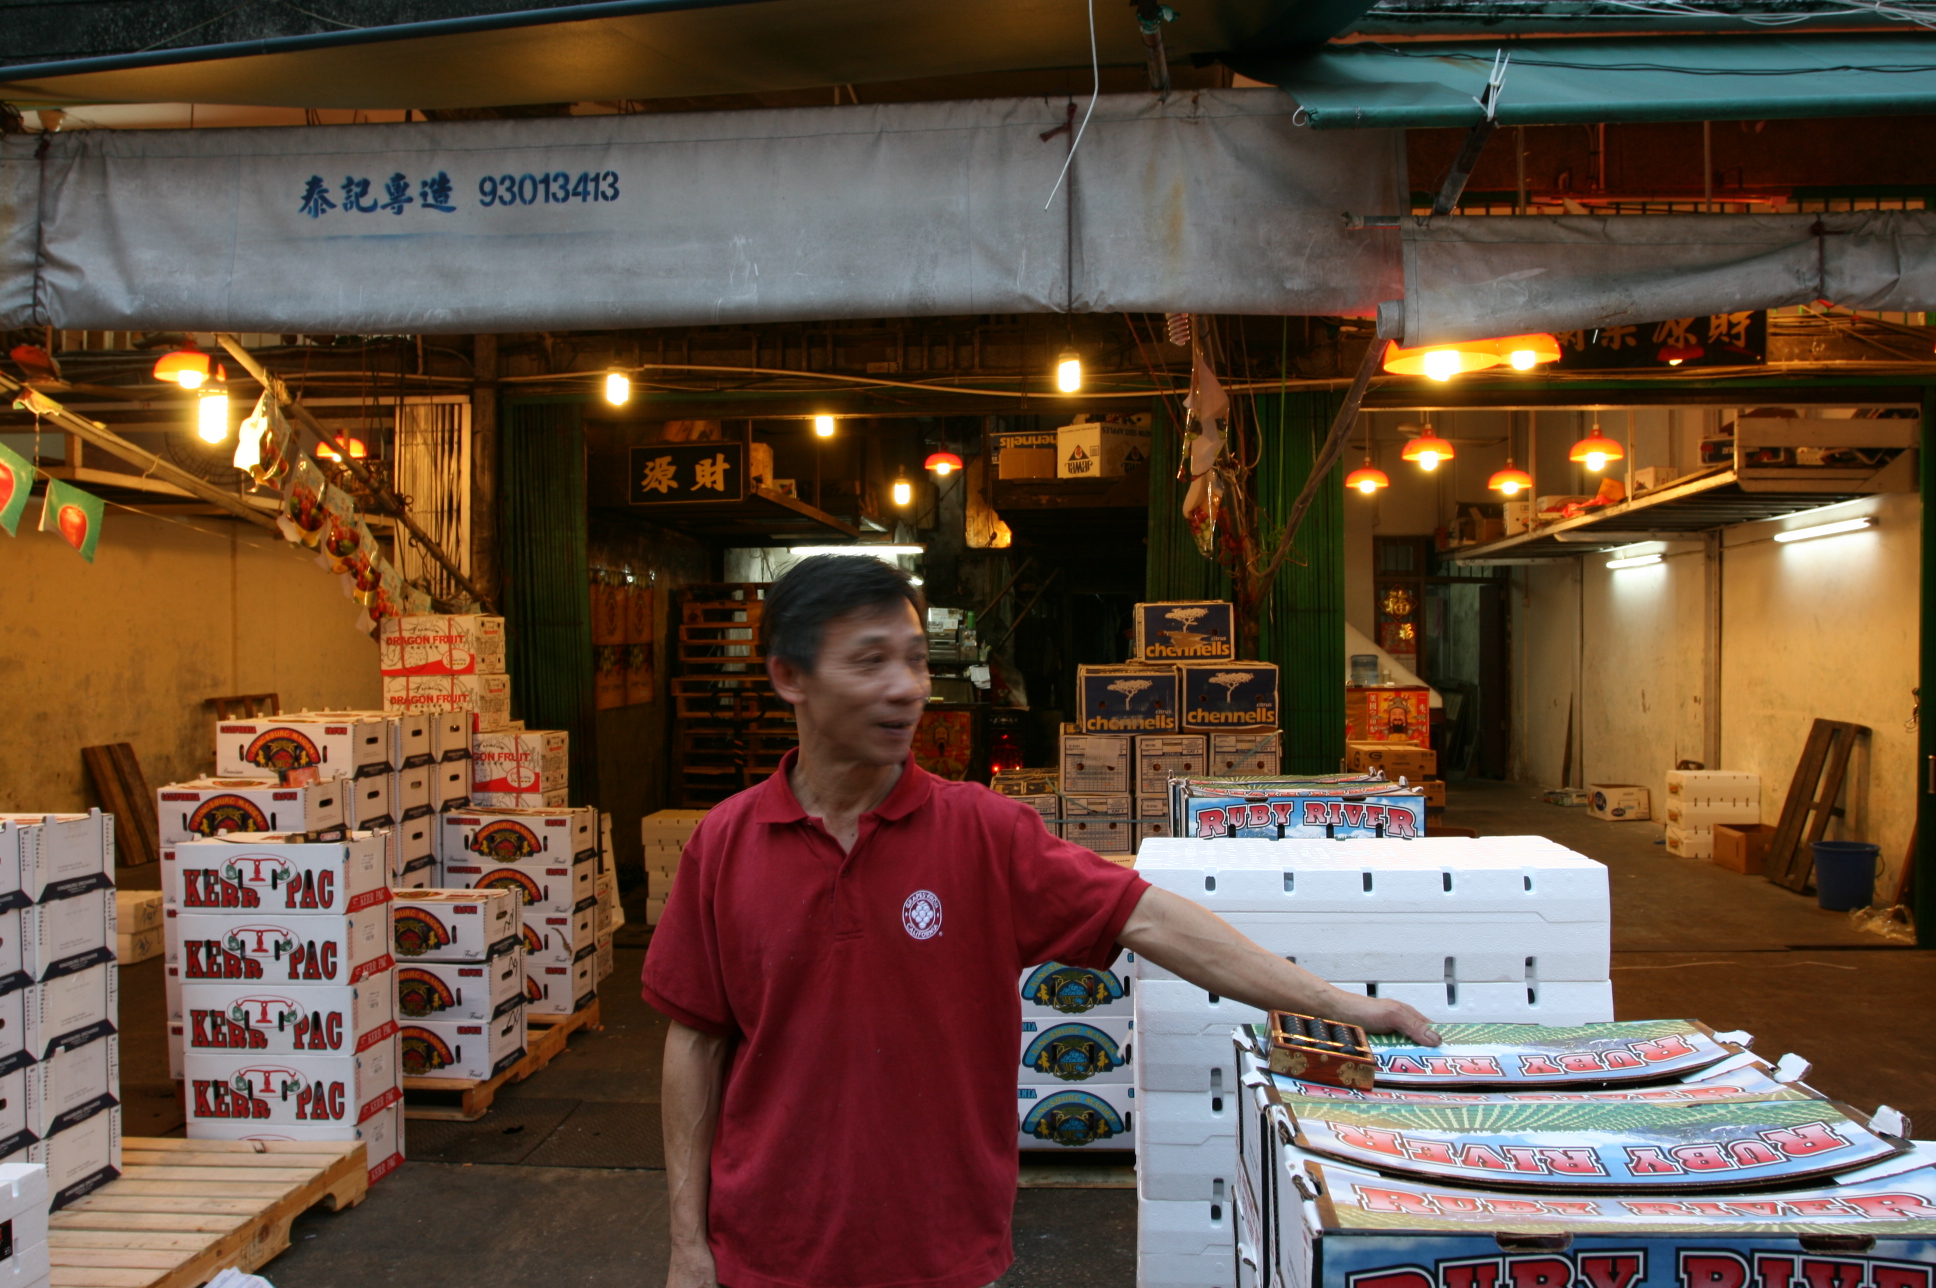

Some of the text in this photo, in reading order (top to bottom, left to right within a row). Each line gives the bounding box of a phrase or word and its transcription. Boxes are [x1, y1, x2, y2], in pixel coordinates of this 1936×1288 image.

[479, 170, 620, 207] 93013413
[386, 635, 465, 646] DRAGON FRUIT
[1146, 642, 1230, 658] chennells
[390, 694, 469, 705] DRAGON FRUIT
[1087, 715, 1175, 730] chennells
[1187, 708, 1275, 723] chennells
[473, 752, 530, 761] GON FRUIT
[1196, 801, 1418, 840] RUBY RIVER
[183, 868, 334, 909] KERR PAC
[359, 891, 374, 906] KERR
[184, 939, 338, 980] KERR PAC
[190, 1009, 342, 1050] KERR PAC
[367, 1028, 382, 1044] KERR
[1032, 1025, 1118, 1056] KINGSBURG MAIDEN
[1374, 1034, 1698, 1078] RUBY RIV
[192, 1079, 345, 1120] KERR PAC
[370, 1096, 384, 1112] KERR
[1031, 1093, 1116, 1125] KINGSBURG MAIDEN
[1325, 1120, 1854, 1177] RUBY RIVER
[371, 1163, 386, 1181] KERR
[1350, 1183, 1936, 1220] RUBY RIVER
